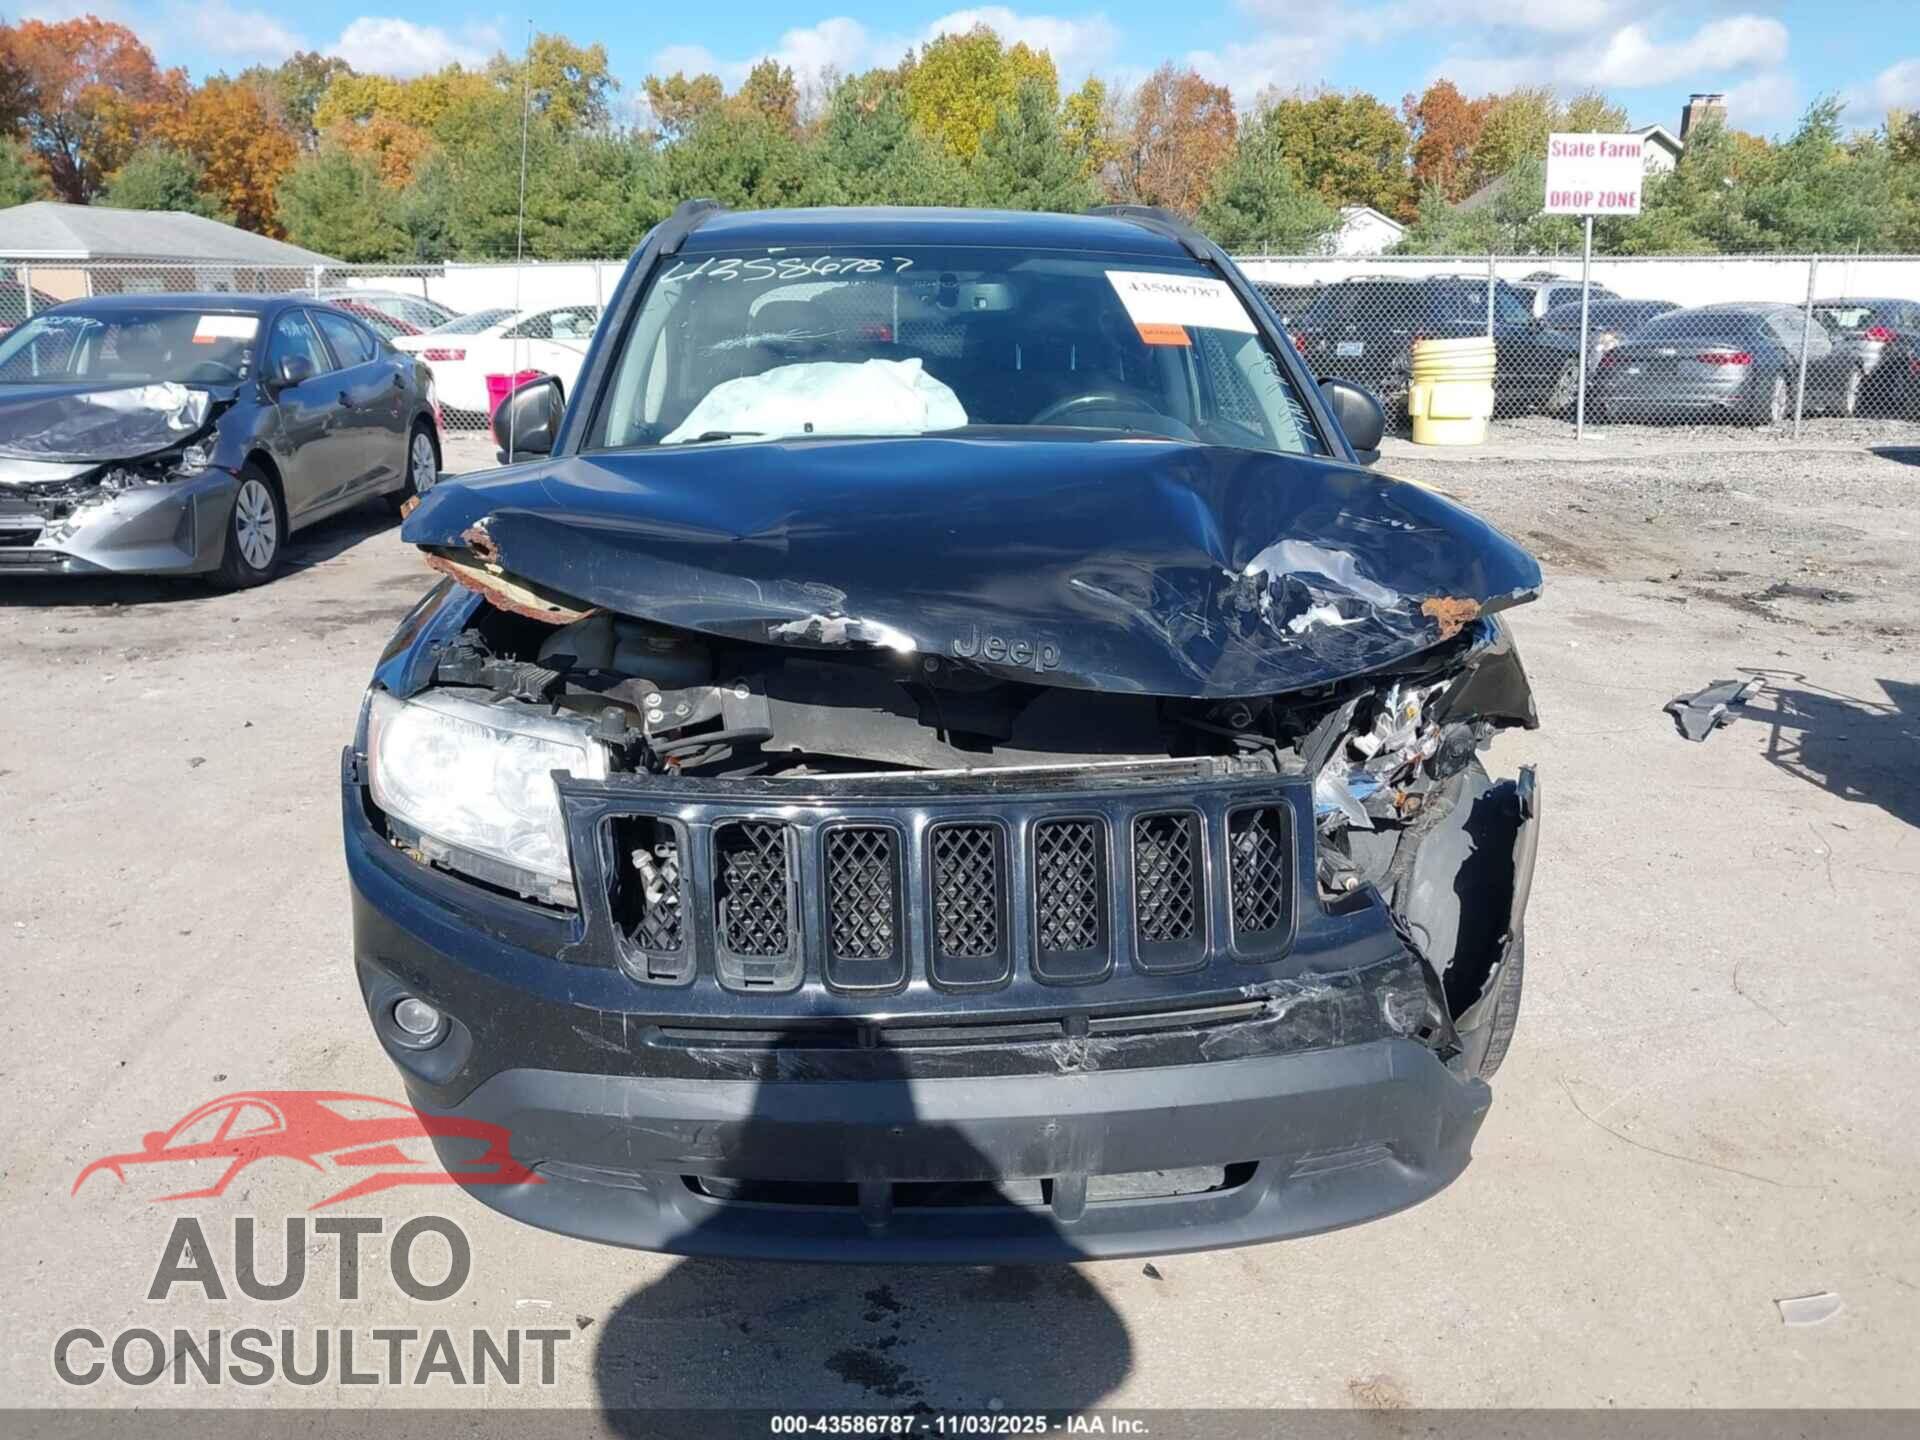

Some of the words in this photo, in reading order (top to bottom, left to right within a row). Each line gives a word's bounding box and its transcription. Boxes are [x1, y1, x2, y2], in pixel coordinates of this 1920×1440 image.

[1551, 140, 1595, 157] State
[1600, 140, 1641, 157] Farm
[1550, 191, 1594, 208] DROP
[1598, 191, 1637, 208] ZONE
[660, 256, 914, 283] 43586787
[953, 624, 1061, 673] Jeep
